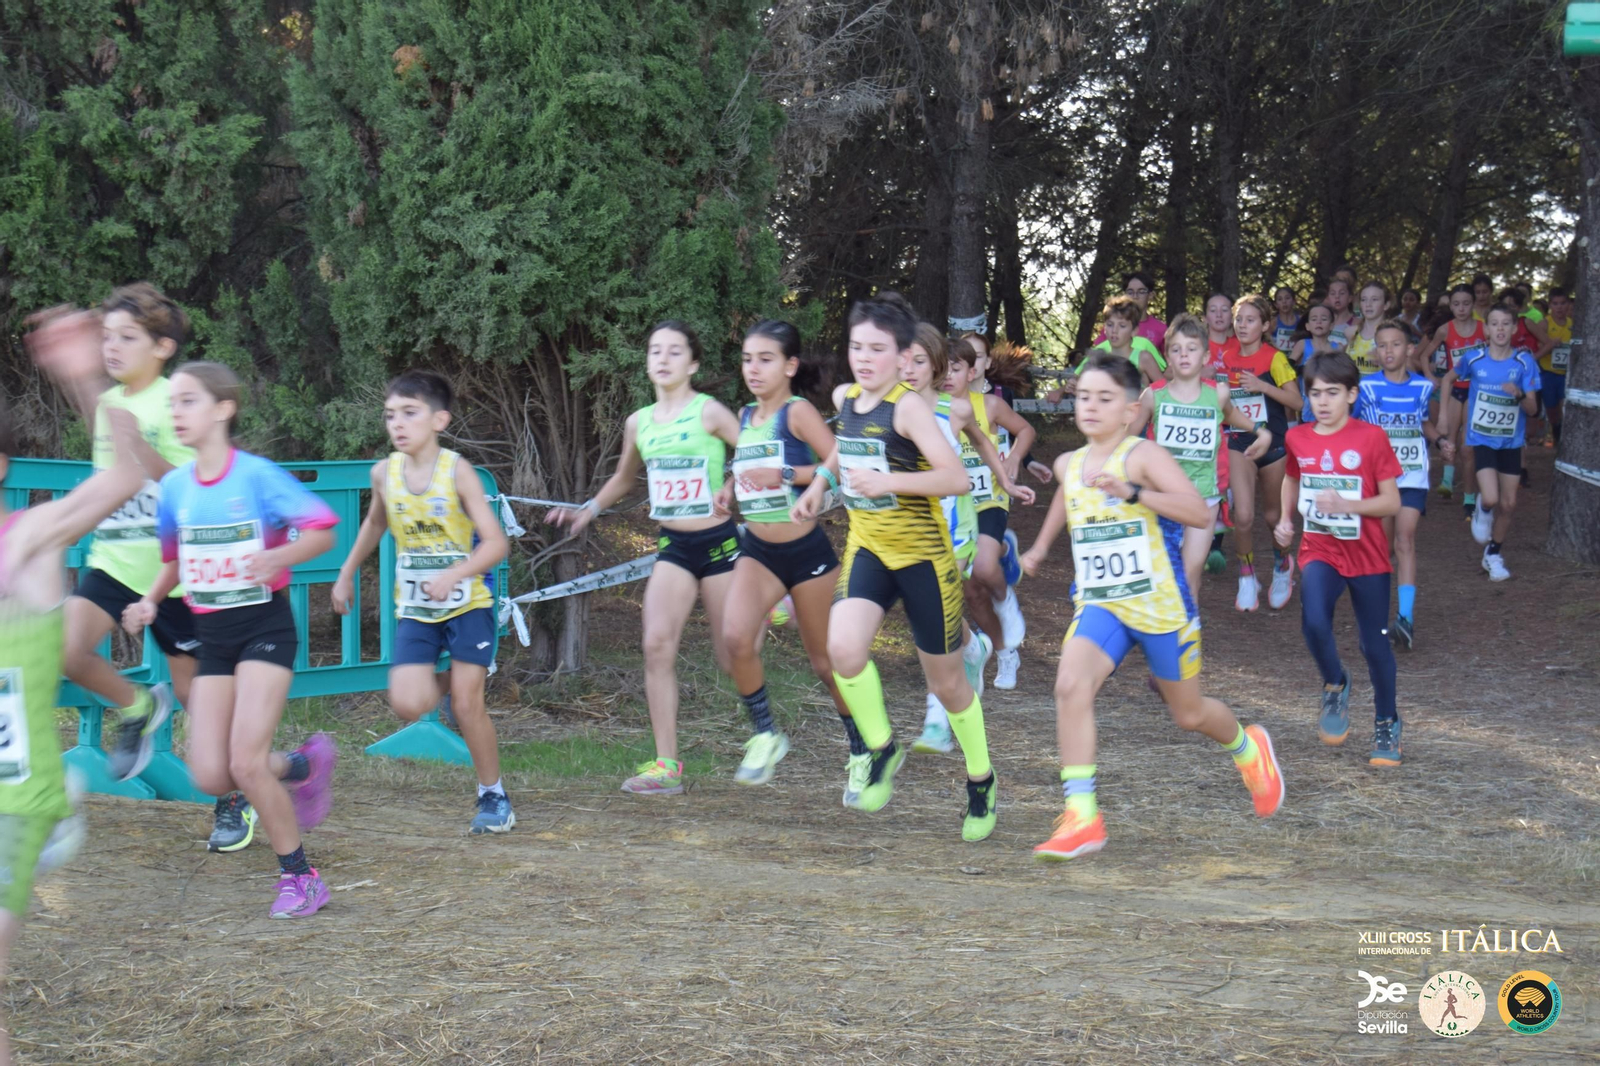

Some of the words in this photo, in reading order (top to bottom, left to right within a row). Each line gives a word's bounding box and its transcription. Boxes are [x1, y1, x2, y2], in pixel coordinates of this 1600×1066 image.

[1176, 408, 1204, 416] ITALICA
[1237, 404, 1262, 419] 37
[1478, 408, 1515, 425] 7929
[1164, 424, 1212, 445] 7858
[1082, 550, 1144, 579] 7901
